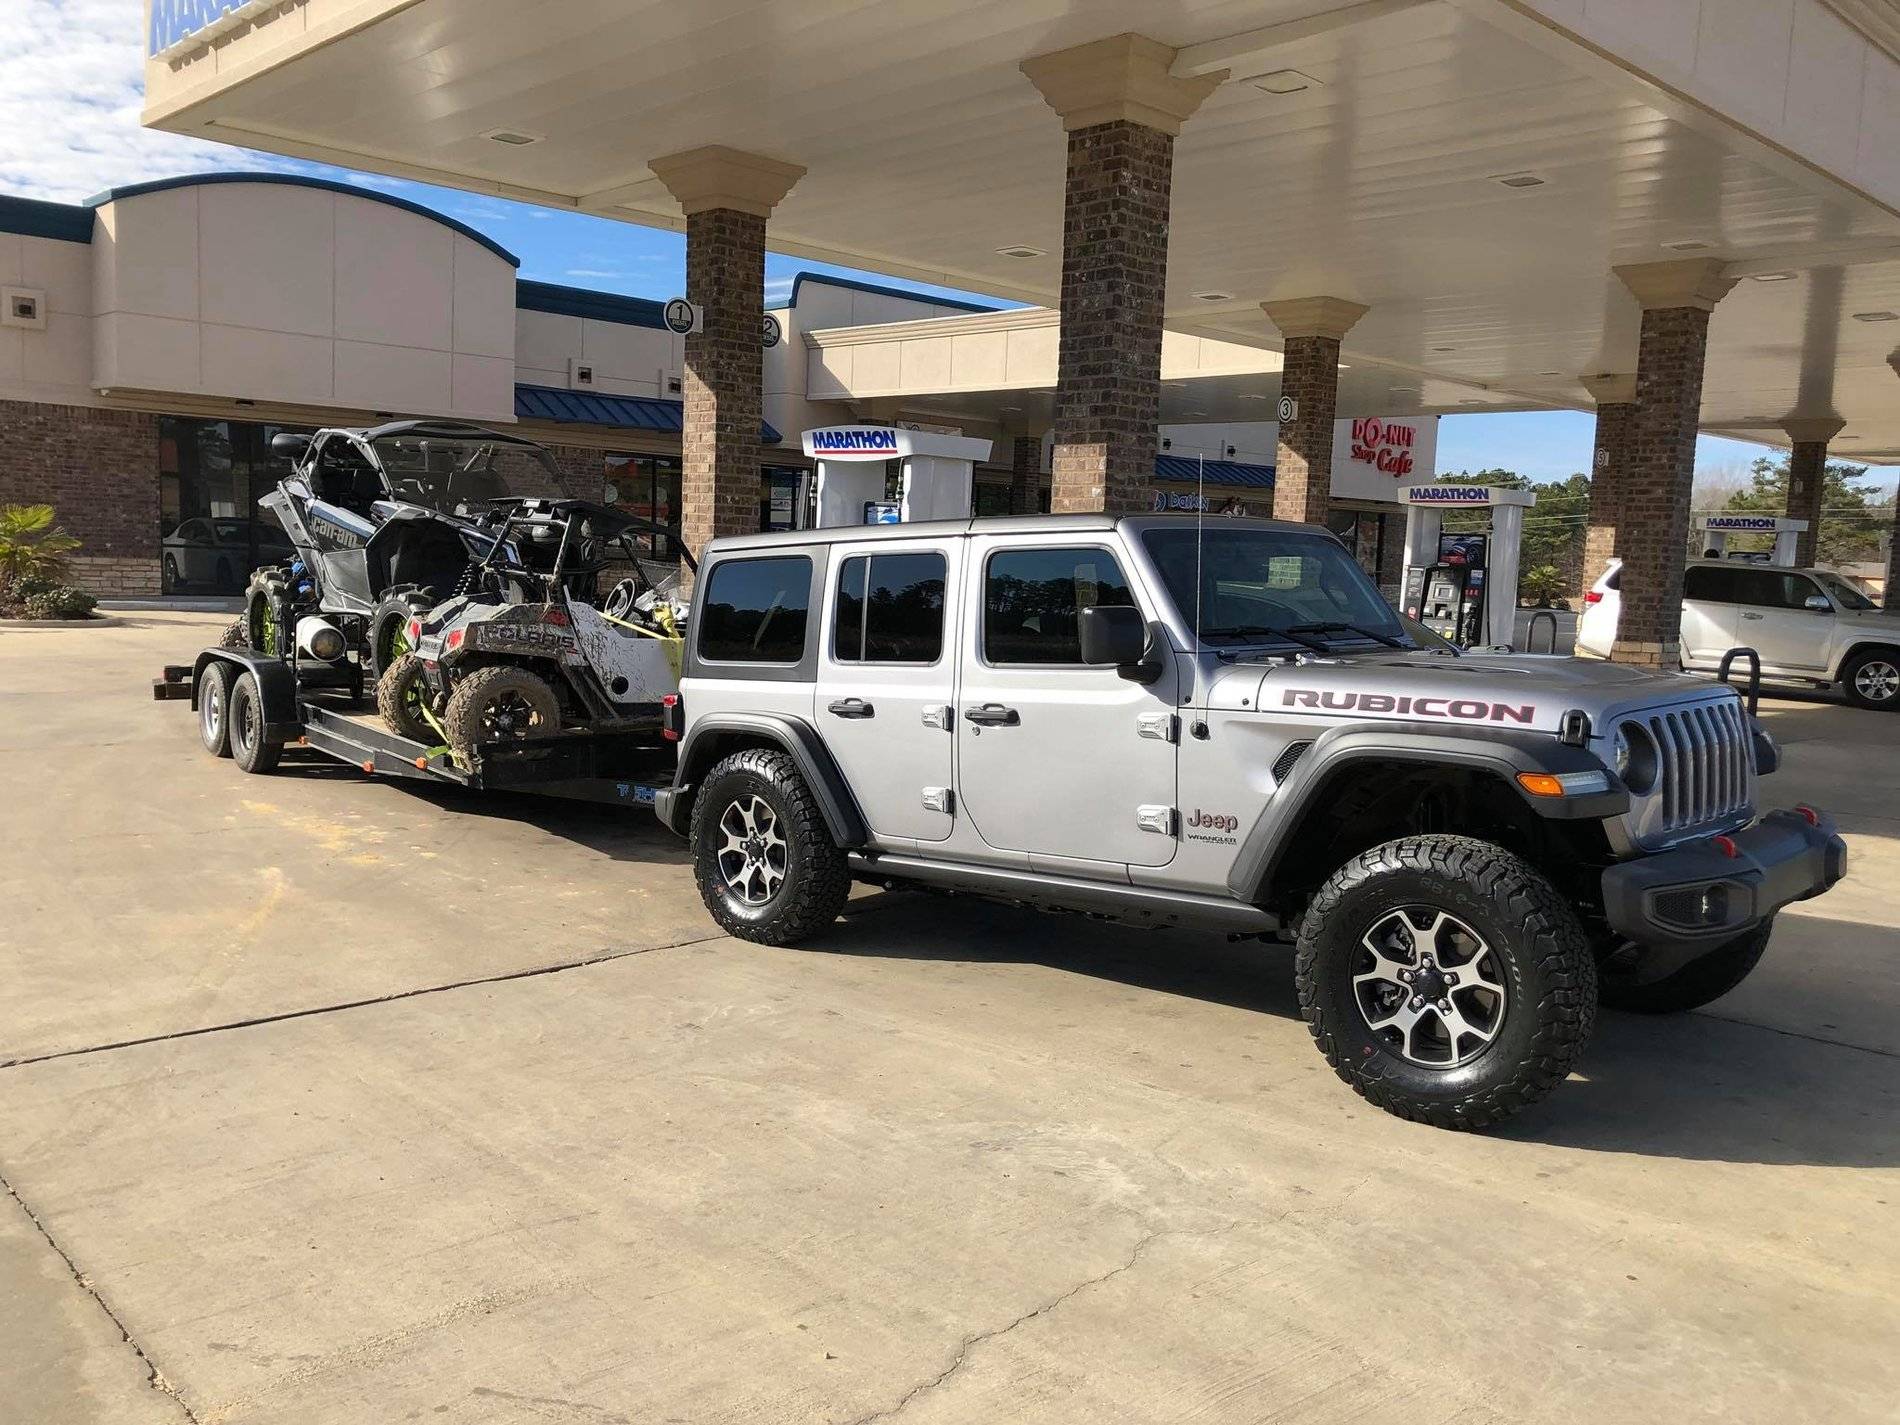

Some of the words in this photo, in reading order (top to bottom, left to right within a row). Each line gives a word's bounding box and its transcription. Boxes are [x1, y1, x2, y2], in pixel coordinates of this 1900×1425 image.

[677, 305, 683, 320] 1
[762, 320, 772, 334] 2
[1282, 403, 1289, 416] 3
[812, 430, 897, 449] MARATHON
[1377, 448, 1413, 478] Cafe
[1409, 488, 1490, 500] MARATHON
[1706, 518, 1776, 528] MARATHON
[488, 624, 575, 650] POLARIS
[1282, 689, 1536, 724] RUBICON
[1187, 808, 1239, 833] Jeep
[1187, 833, 1238, 844] WRANGLER
